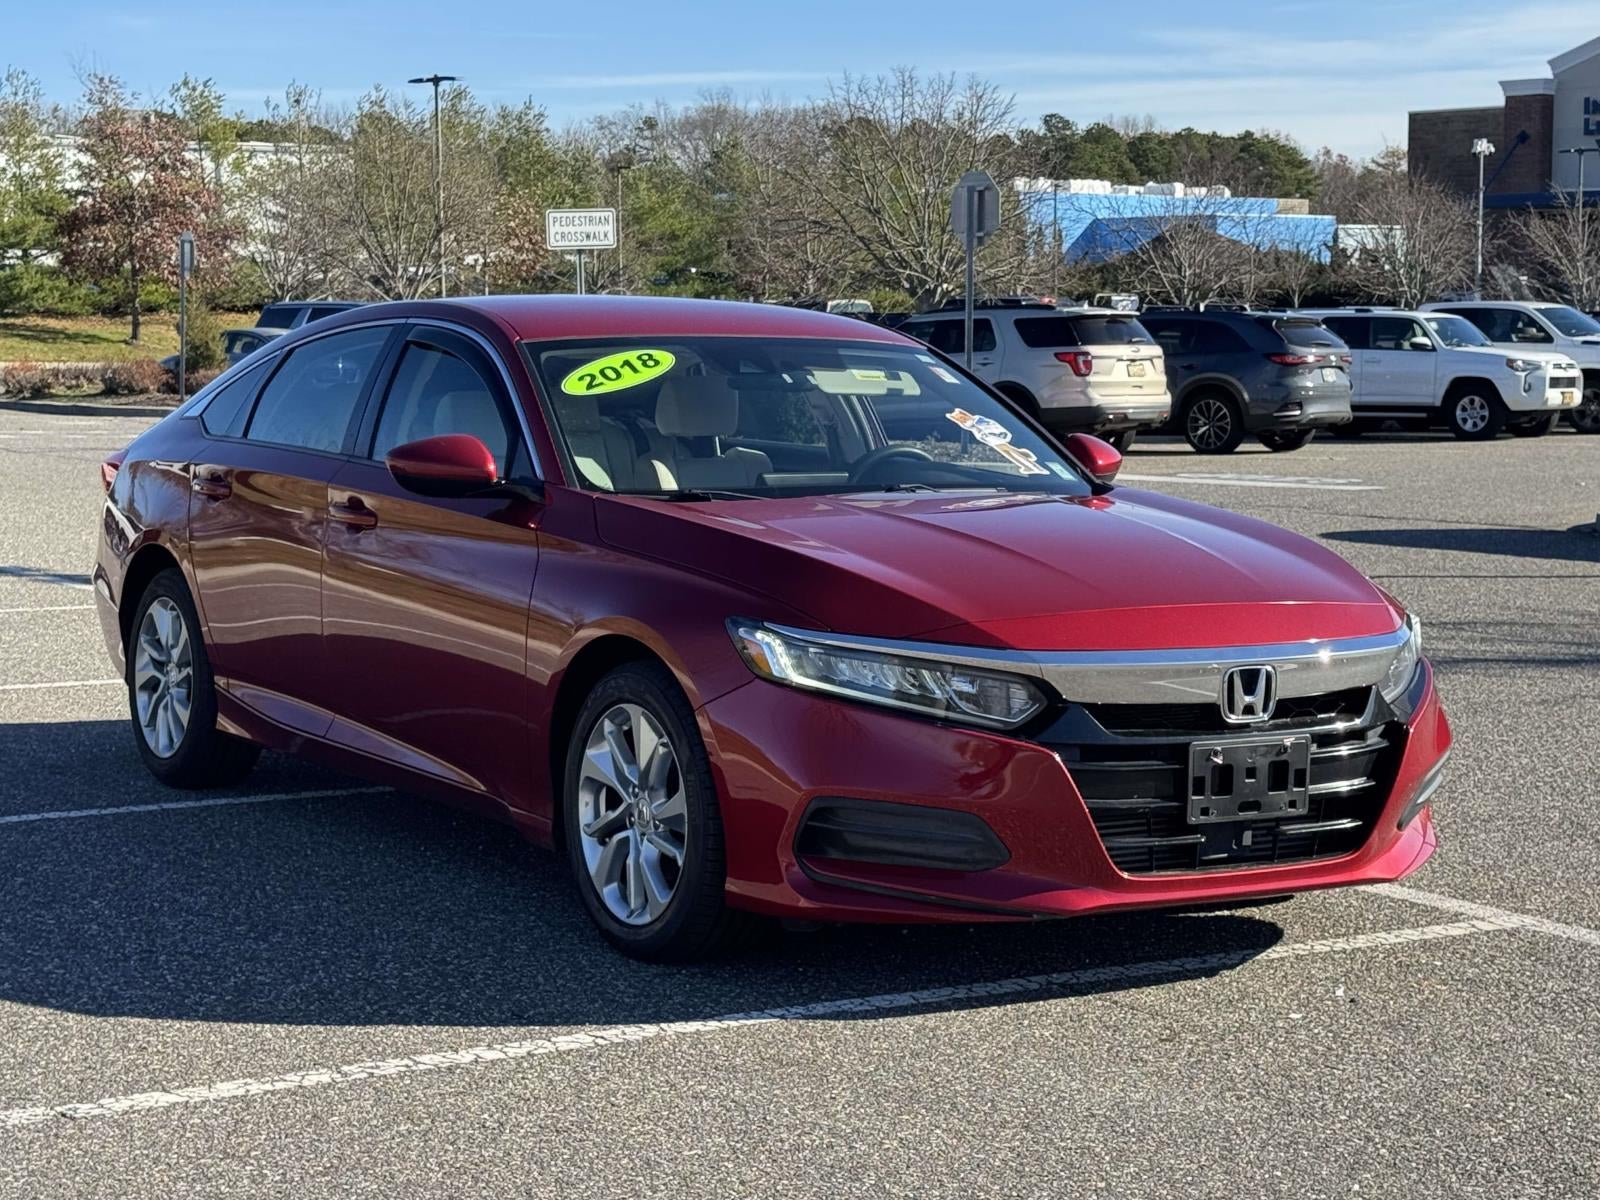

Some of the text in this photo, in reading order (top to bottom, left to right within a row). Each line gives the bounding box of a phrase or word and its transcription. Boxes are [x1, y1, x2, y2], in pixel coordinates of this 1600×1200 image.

[552, 215, 610, 227] PEDESTRIAN
[553, 231, 610, 242] CROSSWALK
[577, 353, 661, 391] 2018
